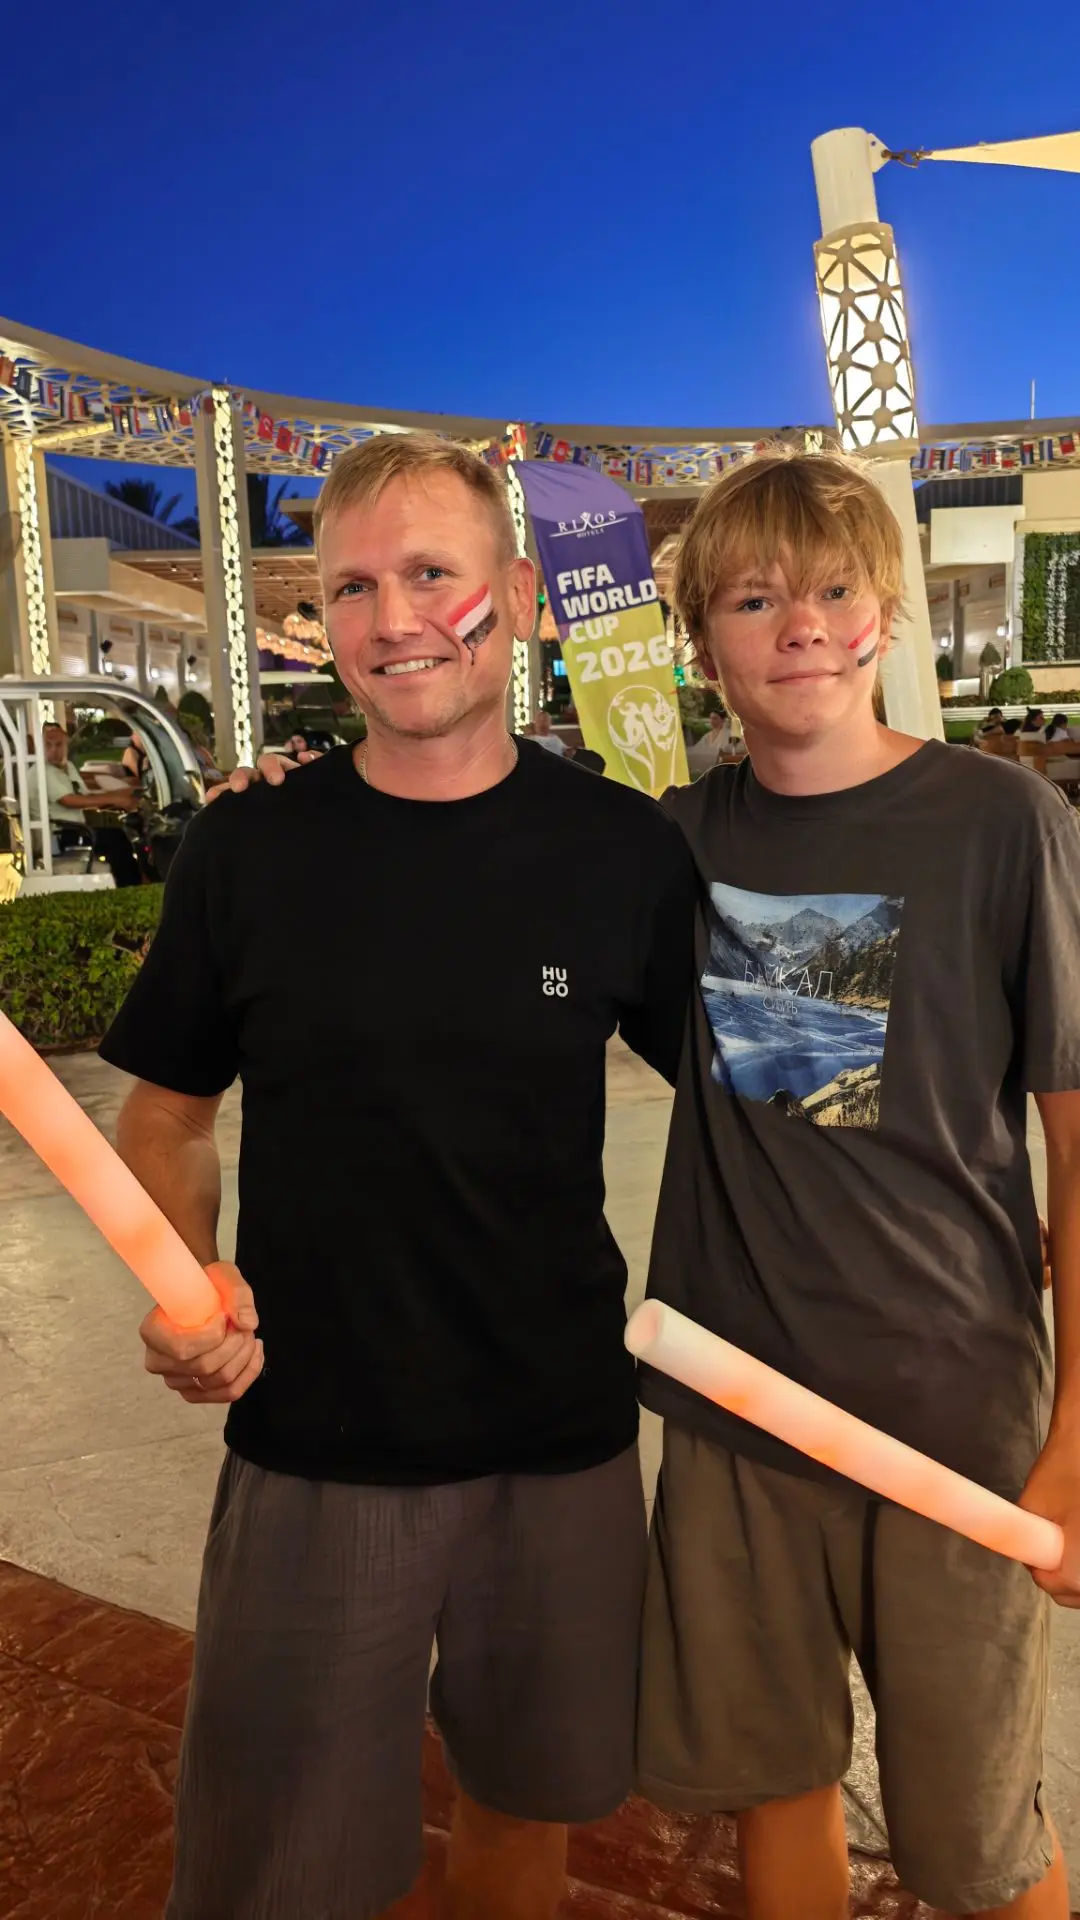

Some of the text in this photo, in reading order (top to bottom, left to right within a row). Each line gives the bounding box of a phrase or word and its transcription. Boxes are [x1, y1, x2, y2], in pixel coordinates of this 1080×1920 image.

[558, 510, 616, 533] RIXOS
[556, 563, 615, 595] FIFA
[561, 578, 658, 619] WORLD
[569, 615, 619, 643] CUP
[576, 634, 673, 683] 2026
[542, 965, 567, 982] HU
[542, 980, 569, 998] GO
